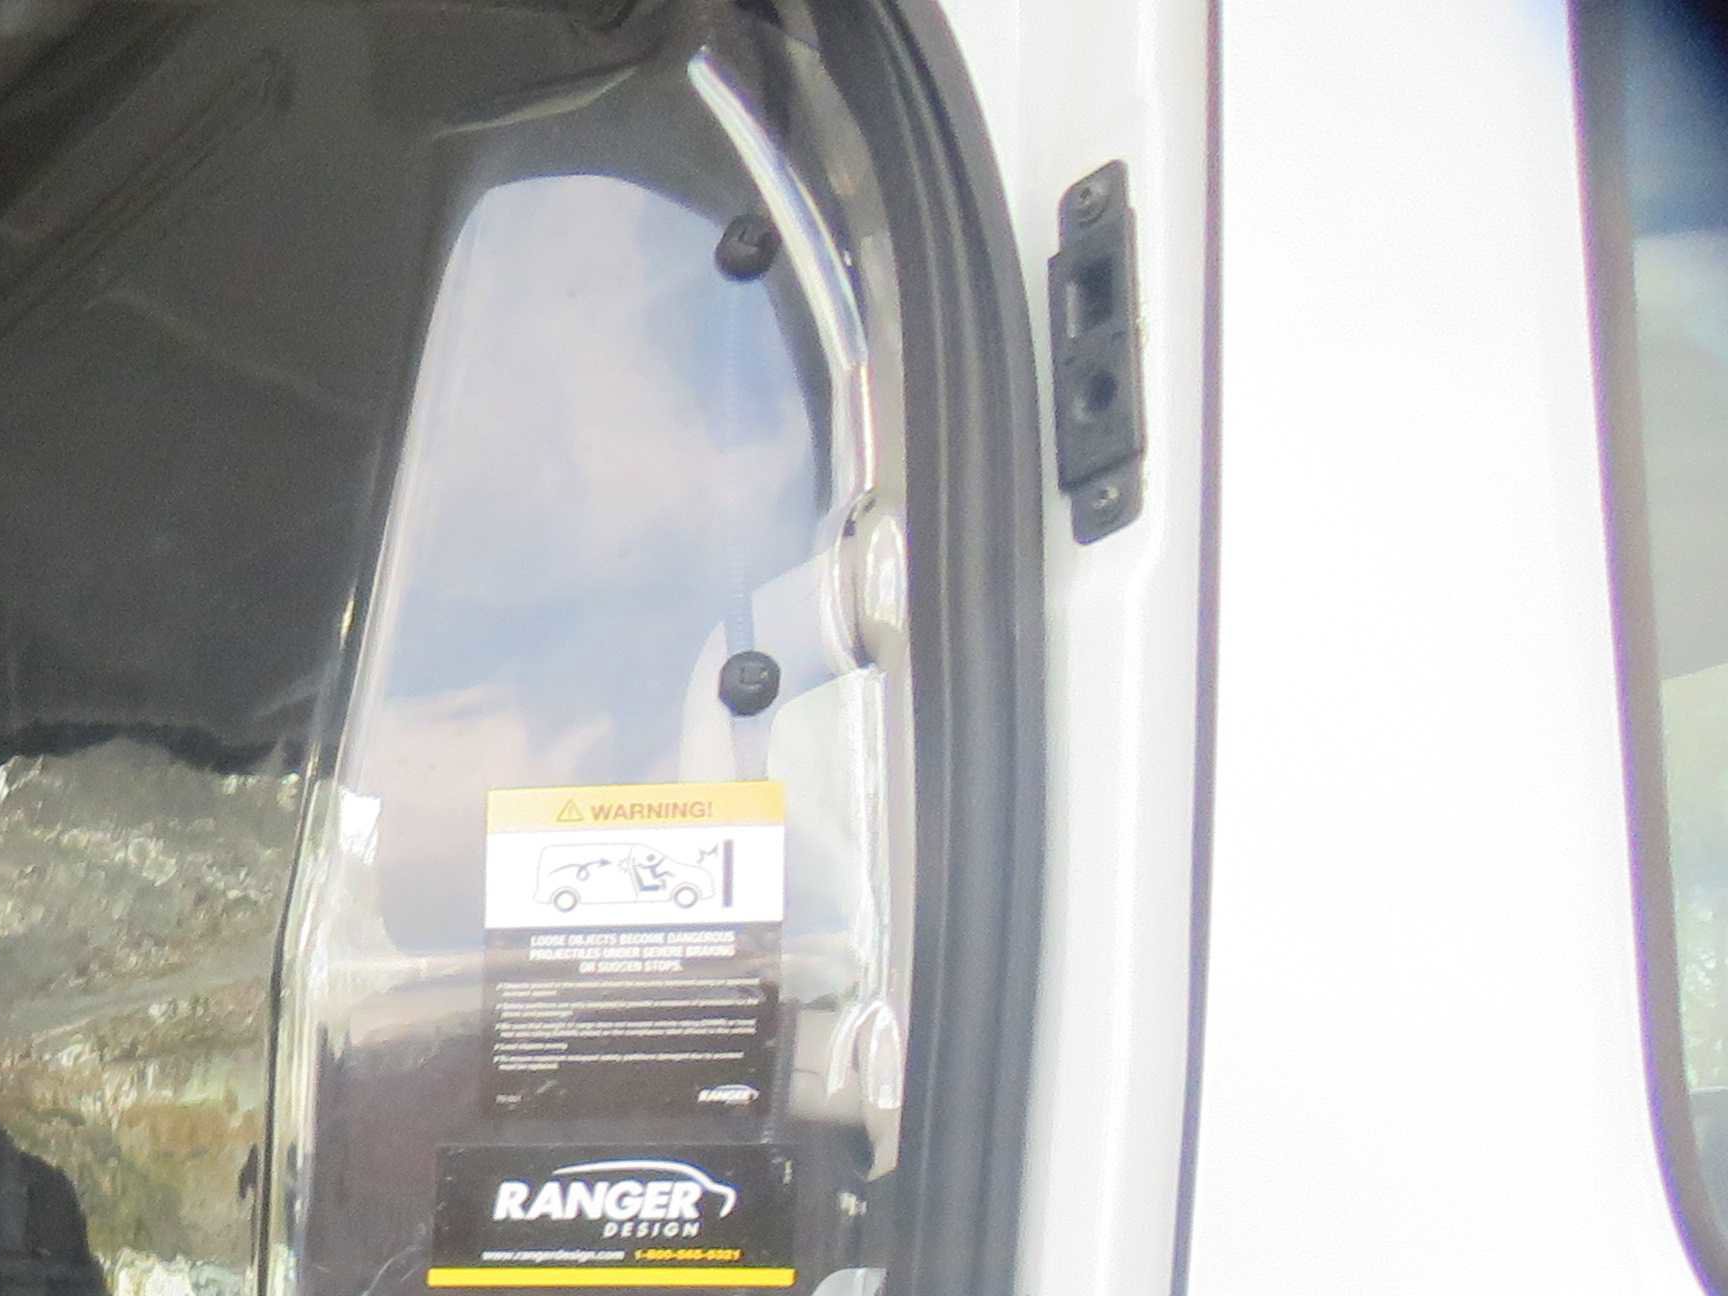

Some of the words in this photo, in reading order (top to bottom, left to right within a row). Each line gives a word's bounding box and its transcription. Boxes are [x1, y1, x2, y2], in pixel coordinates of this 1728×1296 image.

[591, 801, 713, 821] WARNING!
[568, 933, 617, 945] OBJECTS
[619, 932, 664, 945] BECOME
[667, 930, 735, 944] DANGEROUS
[529, 947, 601, 960] PROJECTILES
[492, 1180, 704, 1221] RANGER
[601, 1222, 701, 1238] DESIGN
